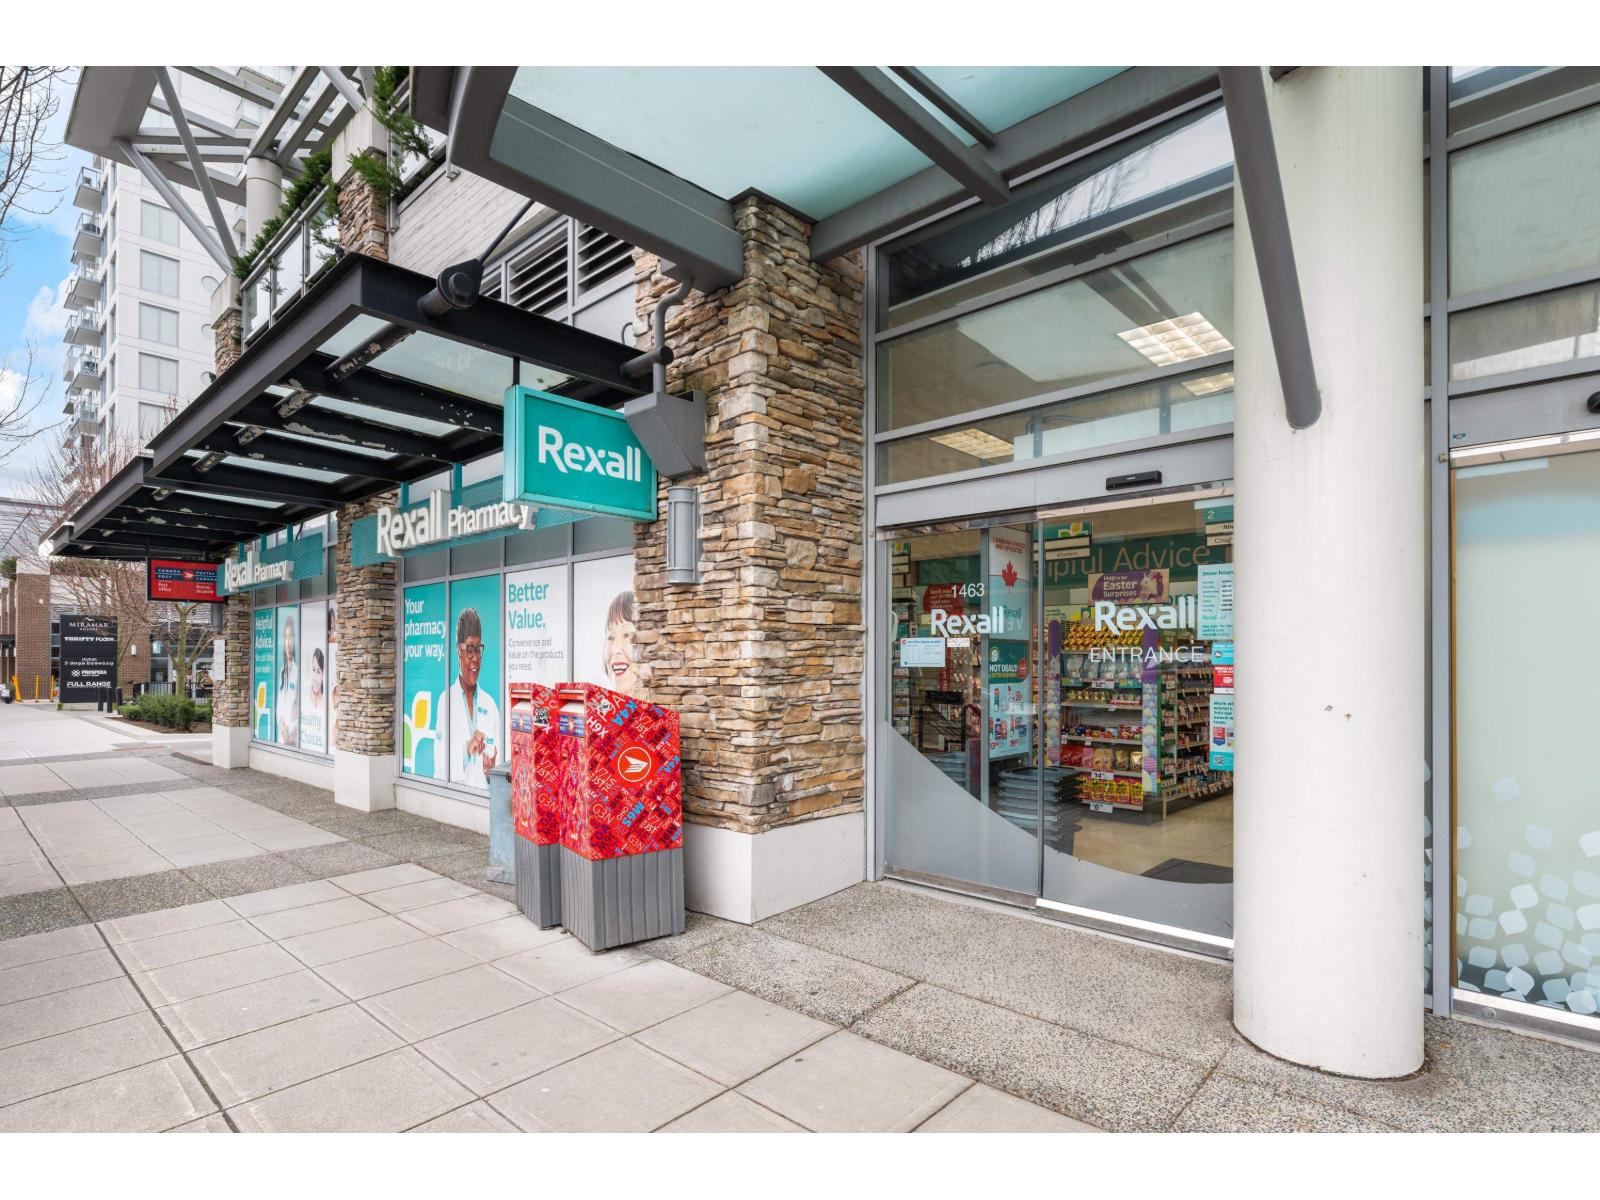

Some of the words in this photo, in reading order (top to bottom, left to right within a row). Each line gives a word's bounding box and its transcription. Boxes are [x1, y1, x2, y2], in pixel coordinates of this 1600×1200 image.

[538, 425, 641, 482] Rexall
[377, 490, 443, 557] Rexall
[448, 503, 529, 538] Pharmacy
[1207, 511, 1215, 519] 2
[1113, 541, 1211, 572] Advice
[224, 549, 254, 592] Rexall
[254, 560, 287, 582] Pharmacy
[508, 582, 549, 603] Better
[952, 582, 985, 598] 1463
[1103, 580, 1138, 591] Easter
[1103, 590, 1137, 598] Surprises
[405, 598, 424, 615] Your
[1094, 596, 1195, 637] Rexall
[255, 614, 272, 633] Helpful
[404, 618, 447, 641] pharmacy
[508, 608, 546, 630] Value.
[931, 605, 1004, 638] Rexall
[404, 644, 424, 662] your
[424, 643, 445, 662] way.
[509, 638, 541, 648] Convenience
[542, 637, 552, 647] and
[1090, 645, 1204, 664] ENTRANCE
[989, 663, 1001, 672] HOT
[1001, 663, 1018, 672] DEALS
[588, 715, 609, 739] H9X
[592, 803, 614, 824] G3N
